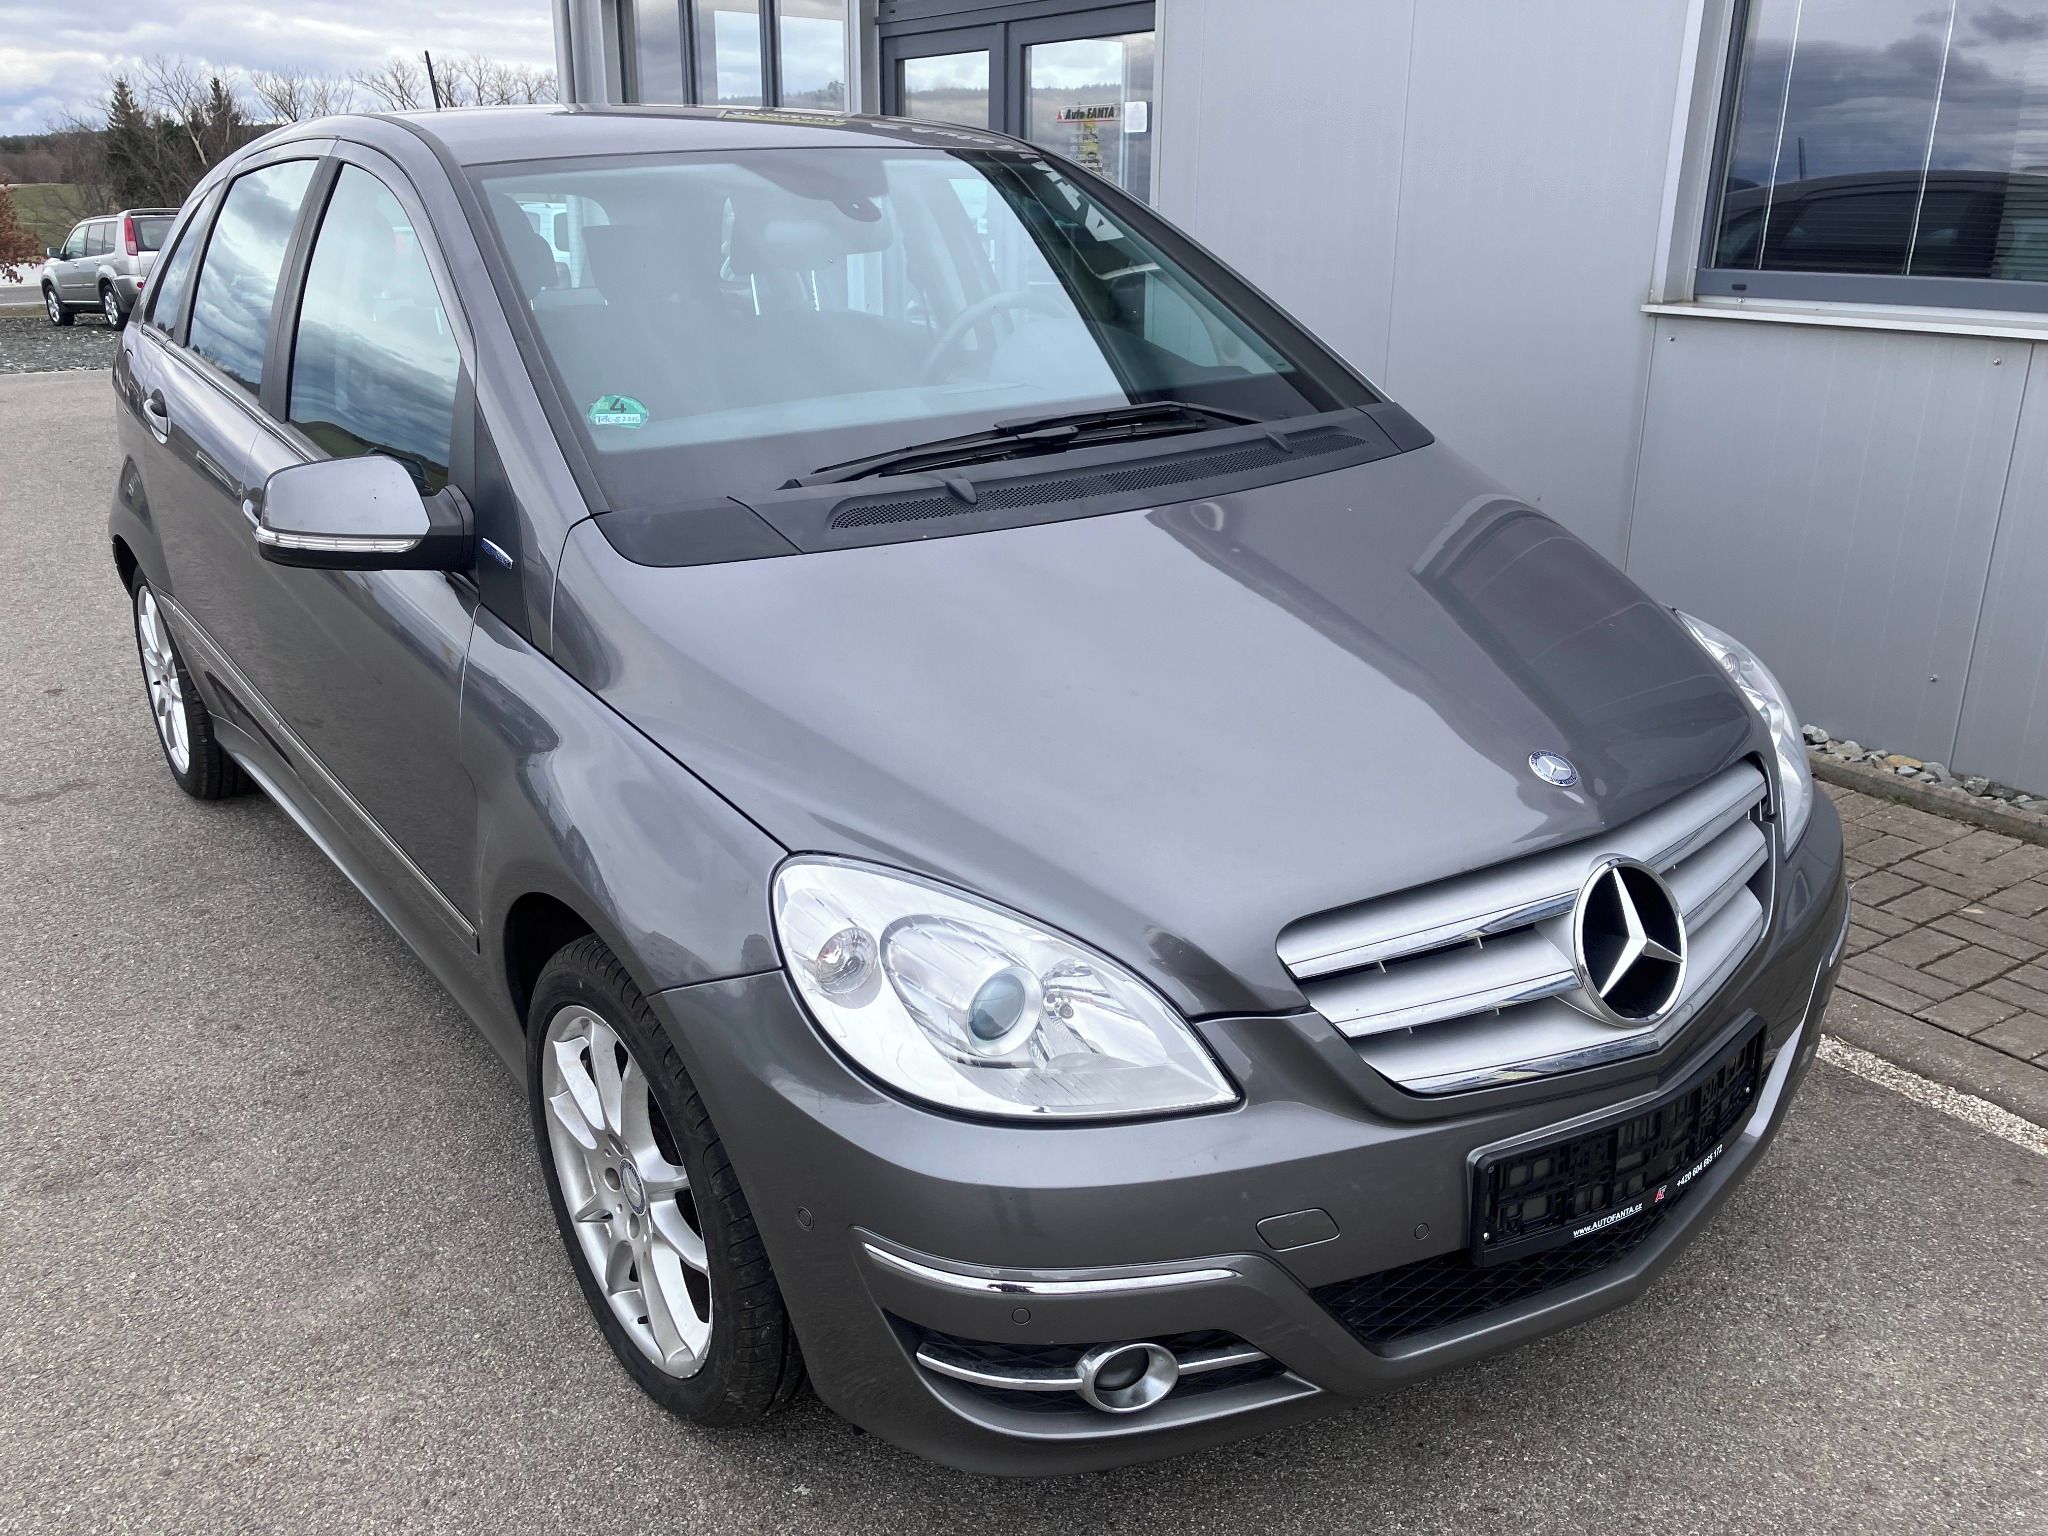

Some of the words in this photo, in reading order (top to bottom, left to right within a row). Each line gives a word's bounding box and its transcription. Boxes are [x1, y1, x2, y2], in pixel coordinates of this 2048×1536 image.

[1064, 108, 1085, 120] Auto
[1086, 106, 1115, 119] FANTA
[610, 398, 627, 414] 4
[1573, 1203, 1643, 1238] www.AUTOFANTA.cz
[1677, 1171, 1692, 1187] +420
